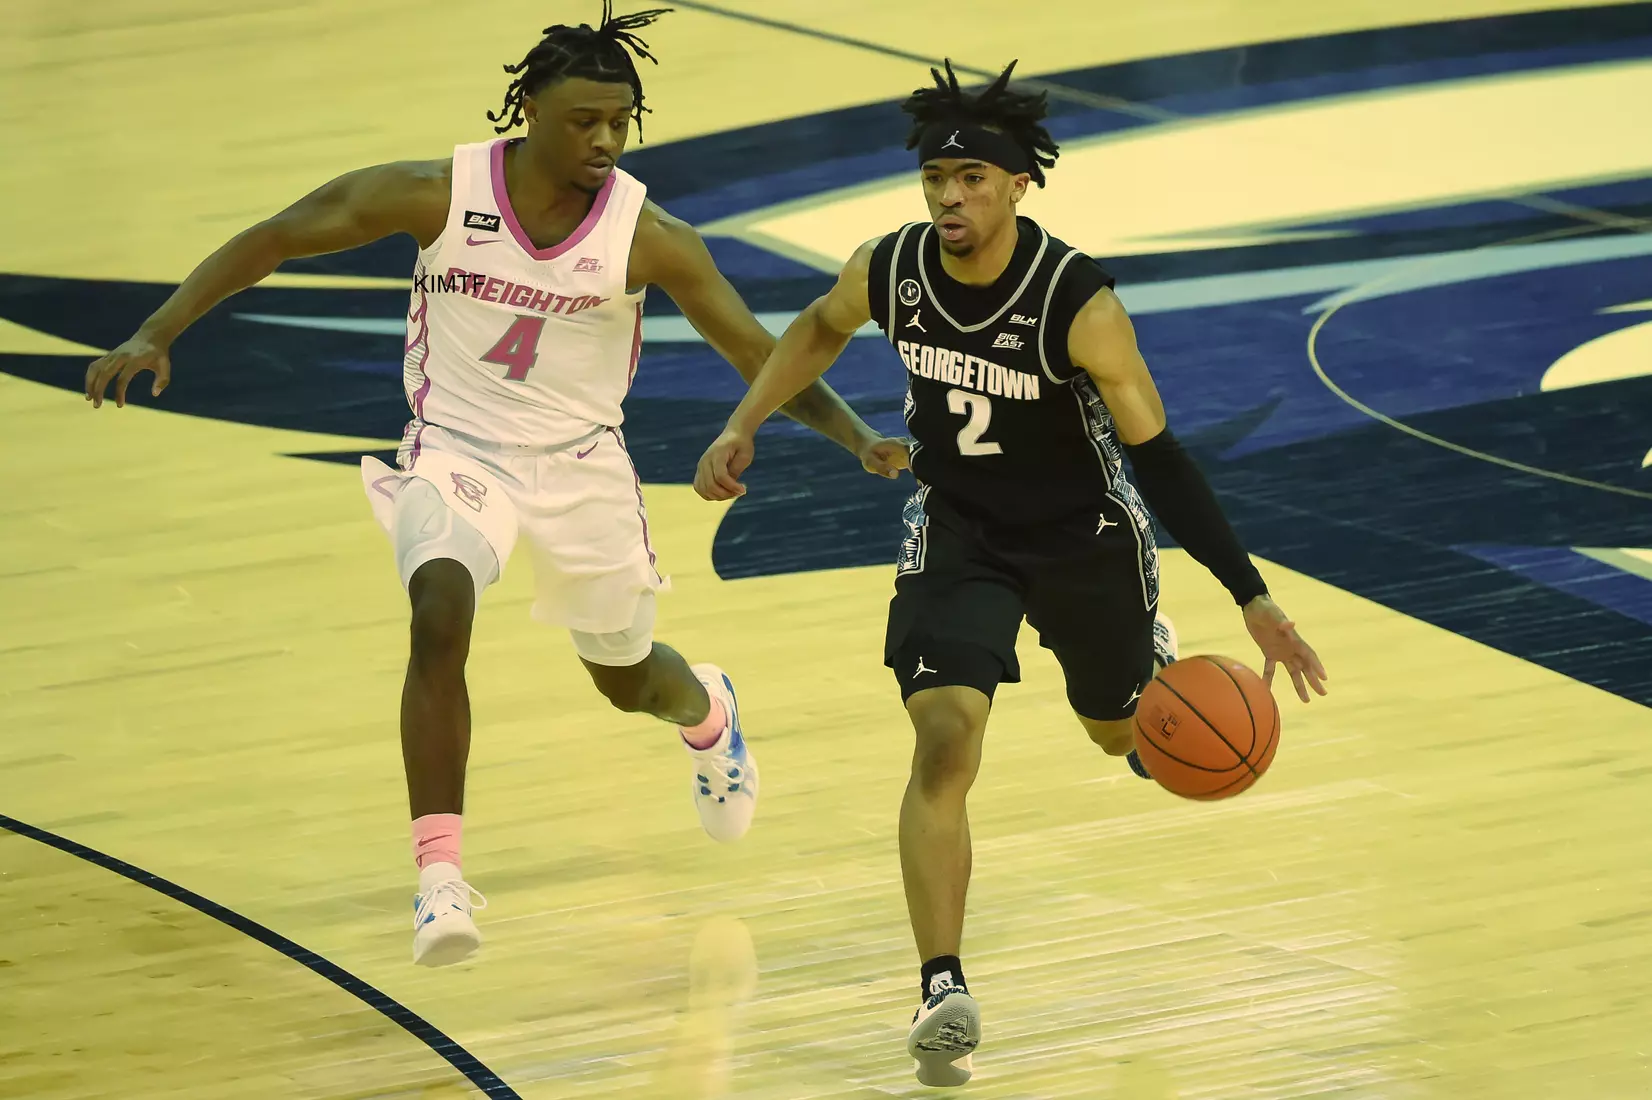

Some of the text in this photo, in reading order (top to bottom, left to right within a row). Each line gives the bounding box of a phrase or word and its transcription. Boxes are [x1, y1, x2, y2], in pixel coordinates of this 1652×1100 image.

[468, 214, 498, 226] BLM
[444, 267, 611, 315] CREIGHTON
[1009, 313, 1038, 325] BLM
[478, 313, 548, 383] 4
[993, 338, 1026, 348] EAST
[997, 332, 1020, 341] BIG
[897, 340, 1041, 401] GEORGETOWN
[946, 388, 1004, 456] 2
